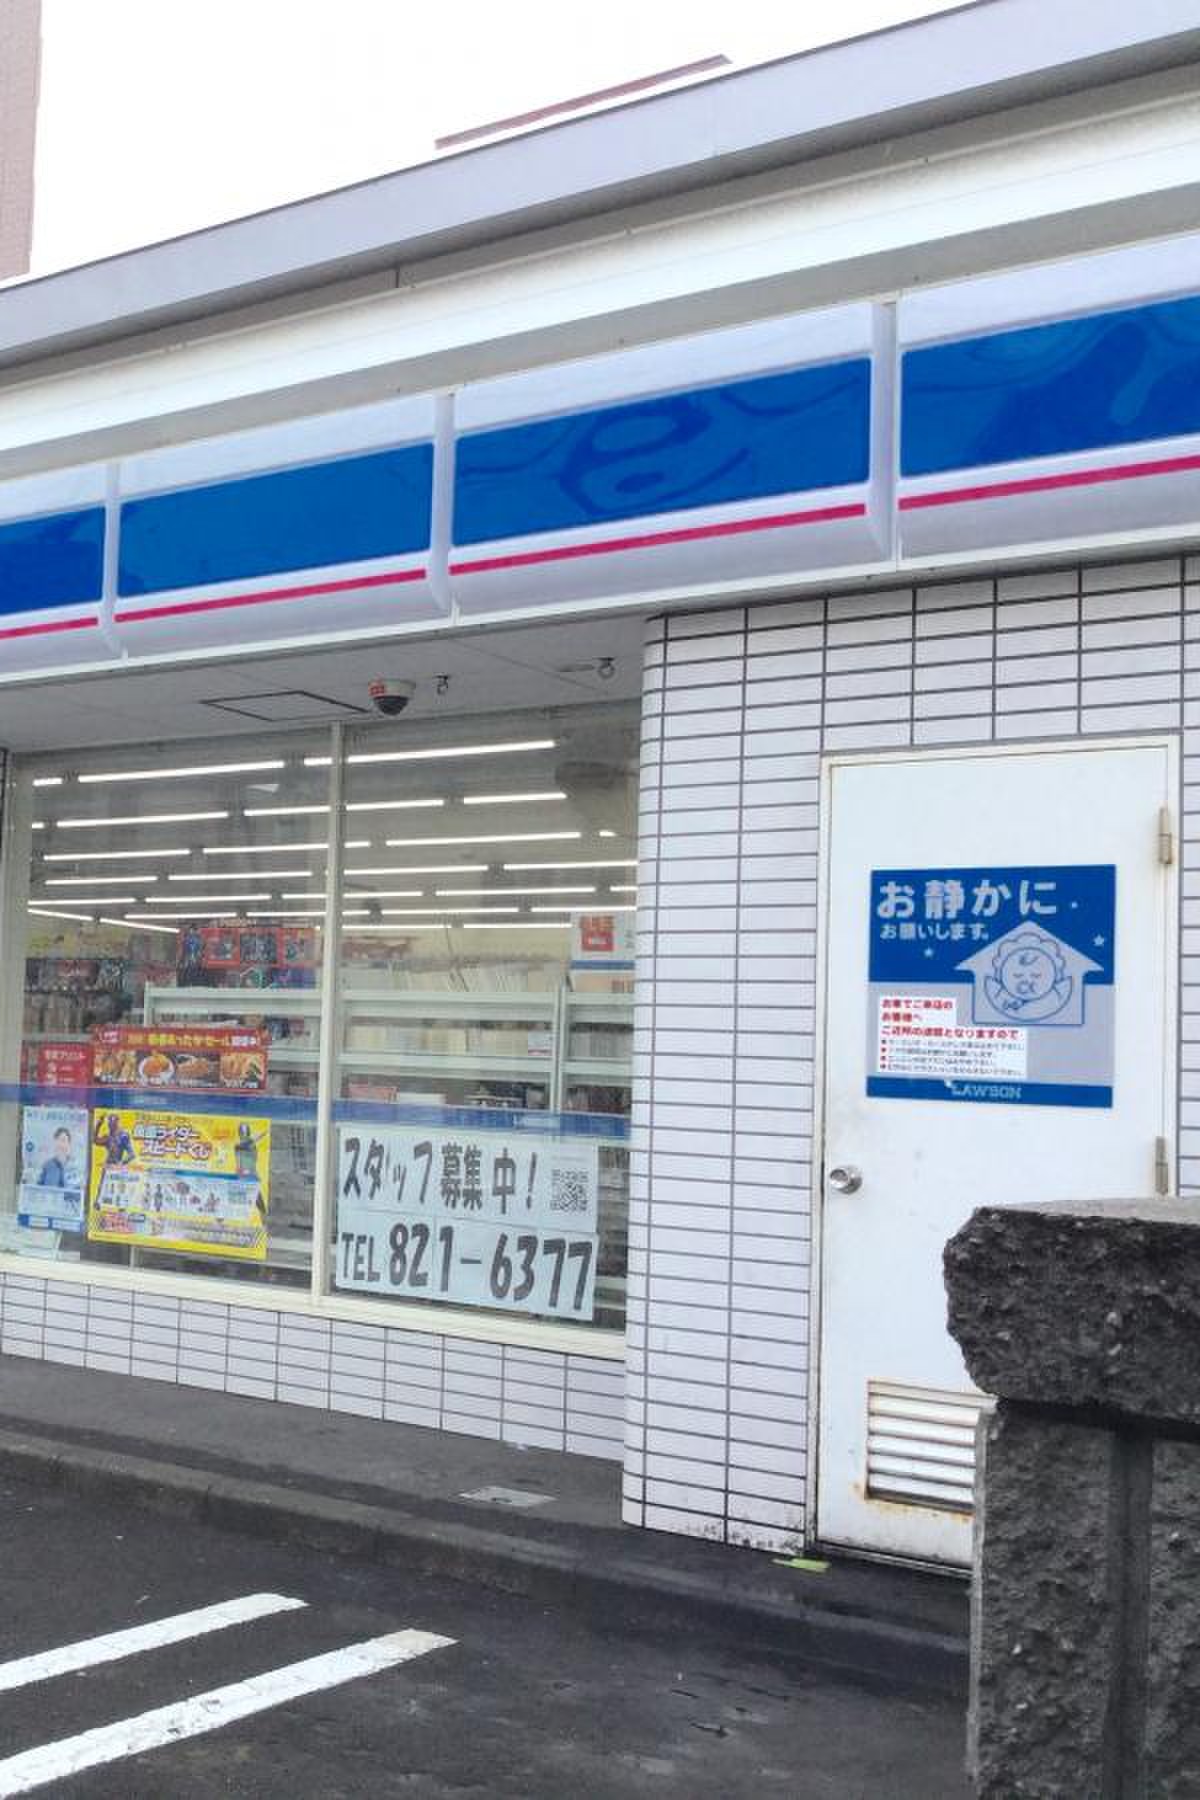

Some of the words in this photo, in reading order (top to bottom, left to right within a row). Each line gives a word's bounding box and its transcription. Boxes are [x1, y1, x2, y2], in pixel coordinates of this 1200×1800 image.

[877, 880, 1057, 919] お静かに
[880, 922, 989, 941] お願いします。
[952, 1083, 1022, 1099] LAWSON
[343, 1137, 537, 1214] スタッフ募集中!
[341, 1232, 381, 1283] TEL
[389, 1223, 593, 1311] 821-6377
